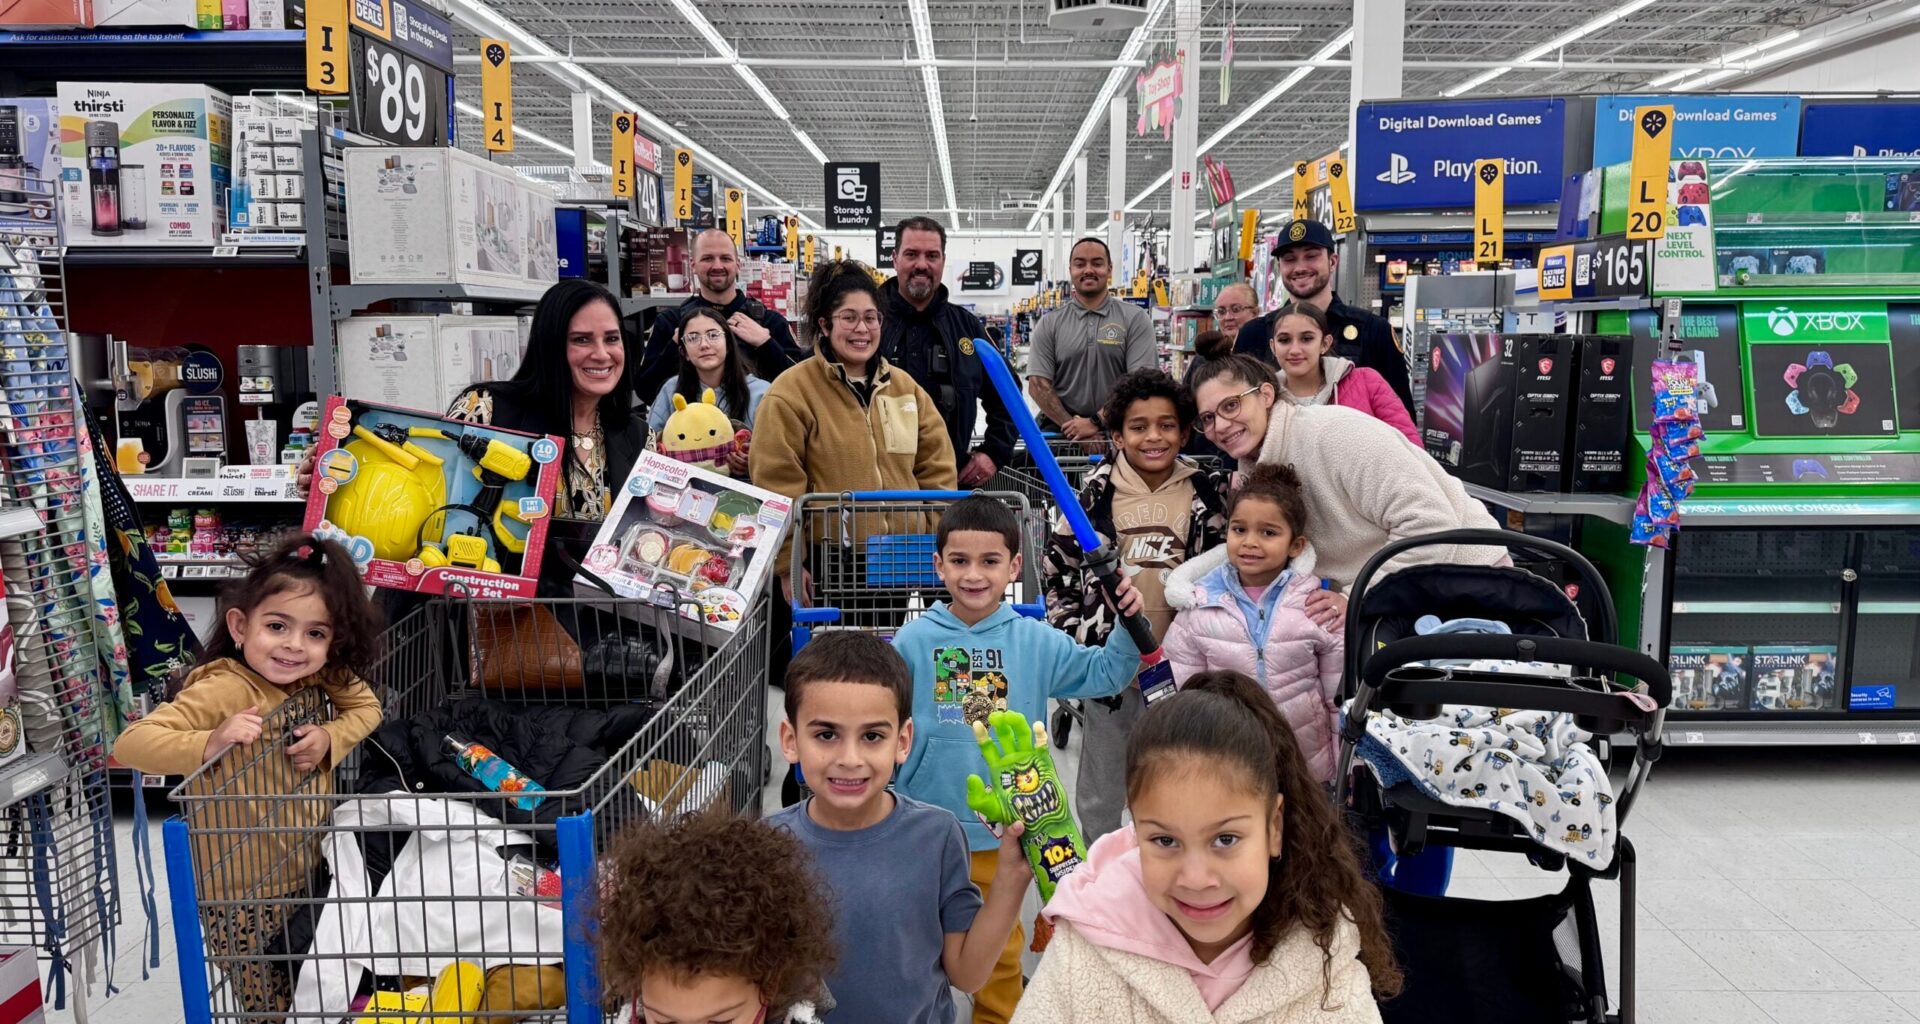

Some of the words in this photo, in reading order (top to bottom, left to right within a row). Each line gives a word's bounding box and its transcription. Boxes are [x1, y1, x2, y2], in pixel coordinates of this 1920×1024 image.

[356, 2, 383, 27] DEALS
[149, 33, 162, 41] top
[164, 32, 185, 40] shelf.
[409, 16, 422, 31] Shop
[436, 29, 448, 44] Deals
[321, 26, 333, 51] I
[416, 31, 424, 43] the
[424, 36, 434, 48] app.
[320, 62, 335, 85] 3
[1148, 84, 1157, 96] Toy
[1158, 76, 1171, 92] Shop
[367, 46, 426, 141] $89
[74, 99, 124, 112] thirsti
[494, 102, 503, 121] I
[152, 110, 195, 119] PERSONALIZE
[1672, 109, 1730, 121] ownload
[1734, 110, 1777, 121] Games
[152, 120, 176, 128] FLAVOR
[178, 120, 182, 128] &
[1380, 116, 1424, 132] Digital
[1428, 114, 1494, 128] Download
[1497, 114, 1542, 126] Games
[492, 128, 505, 146] 4
[156, 144, 168, 152] 20+
[620, 160, 626, 174] I
[618, 180, 626, 192] 5
[1640, 180, 1655, 204] L
[680, 188, 686, 200] I
[679, 205, 686, 216] 6
[834, 206, 864, 216] Storage
[865, 206, 872, 214] &
[1296, 198, 1307, 210] M
[1338, 200, 1347, 214] L
[732, 220, 736, 230] I
[837, 216, 869, 225] Laundry
[1338, 216, 1353, 230] 22
[1482, 218, 1493, 236] L
[1630, 212, 1662, 232] 20
[1666, 232, 1694, 240] NEXT
[1480, 242, 1497, 257] 21
[1657, 250, 1705, 258] CONTROL
[1596, 245, 1644, 286] $165
[1543, 274, 1565, 288] DEALS
[1696, 316, 1717, 326] BEST
[1804, 312, 1865, 330] XBOX
[1687, 327, 1719, 338] GAMING
[1504, 339, 1514, 358] 32
[538, 444, 552, 454] 10
[644, 456, 688, 478] Hopscotch
[133, 484, 166, 496] SHARE
[168, 484, 178, 496] IT.
[1690, 505, 1726, 513] XBOX
[1737, 504, 1792, 513] GAMING
[1795, 503, 1861, 512] CONSOLES
[1127, 536, 1174, 559] NIKE
[439, 571, 520, 591] Construction
[482, 588, 502, 598] Set
[972, 648, 983, 668] EST
[986, 649, 1003, 669] 91
[1754, 655, 1806, 664] STARLINK
[1044, 844, 1073, 866] 10+
